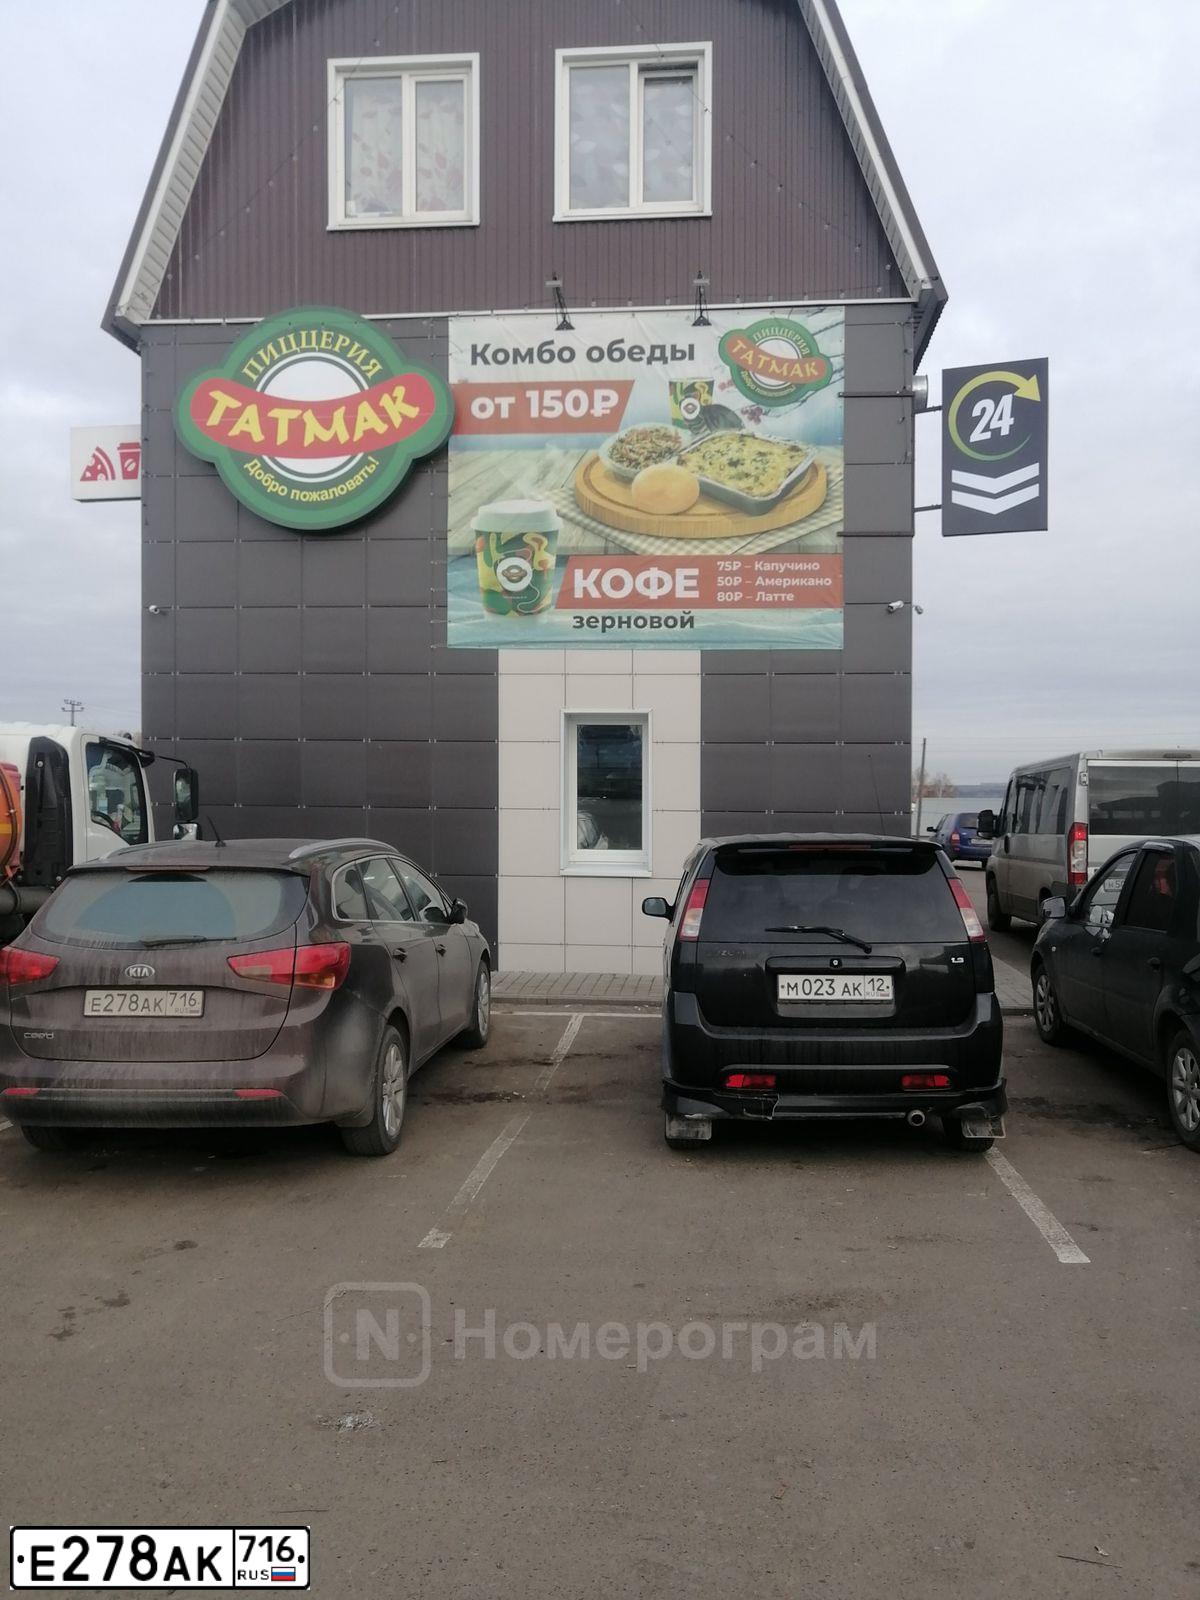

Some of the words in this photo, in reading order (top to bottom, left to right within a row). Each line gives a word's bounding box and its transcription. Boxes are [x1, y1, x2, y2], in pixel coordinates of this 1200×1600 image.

[242, 329, 383, 382] ПИЦЦЕРИЯ
[470, 340, 576, 366] Комбо
[586, 339, 695, 365] обеды
[732, 340, 819, 378] ТАТМАК
[206, 385, 420, 448] ТАТМАК
[470, 394, 516, 420] от
[969, 393, 1014, 443] 24
[243, 458, 288, 497] Добро
[290, 456, 380, 502] пожаловать!
[754, 560, 820, 573] Капучино
[573, 566, 700, 600] КОФЕ
[754, 576, 832, 588] Американо
[755, 592, 795, 602] Латте
[572, 611, 695, 632] зерновой
[129, 966, 149, 978] KIA
